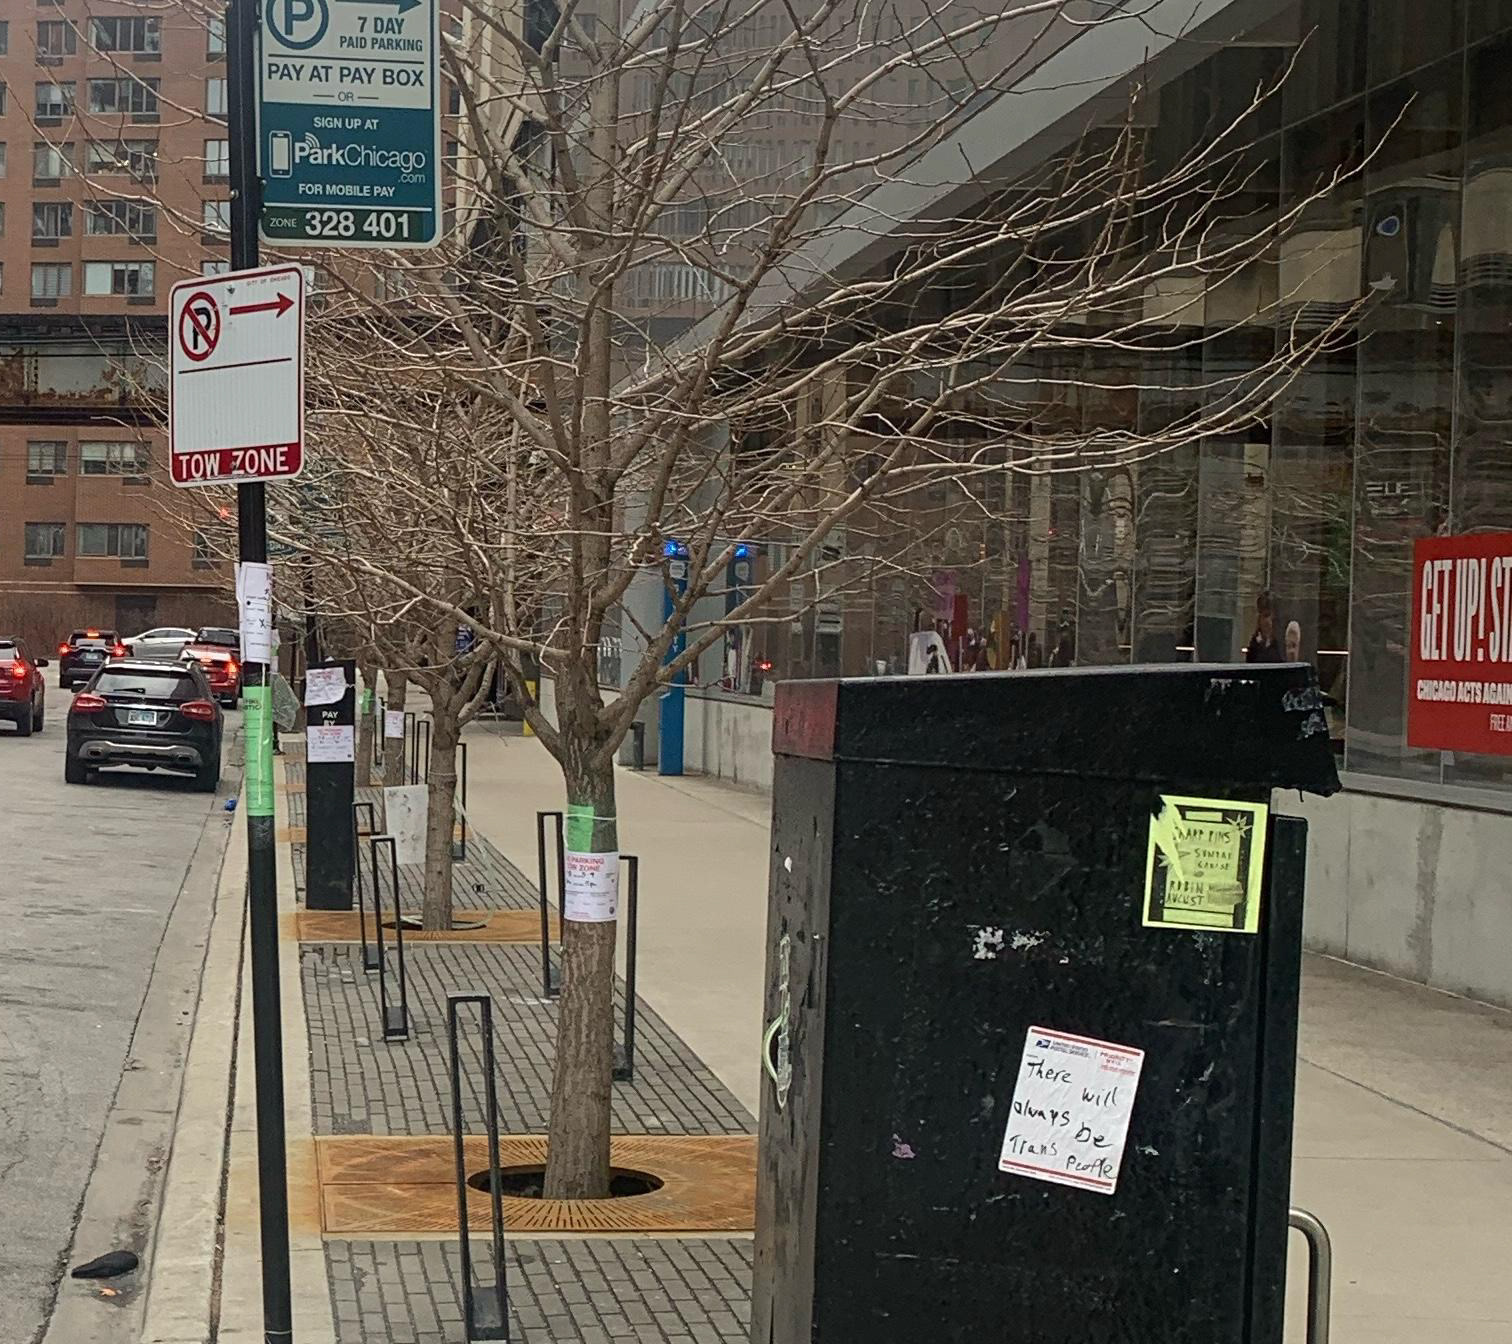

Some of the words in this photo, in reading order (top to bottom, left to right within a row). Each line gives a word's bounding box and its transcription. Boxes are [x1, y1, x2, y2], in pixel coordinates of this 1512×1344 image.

[357, 16, 368, 33] 7
[373, 17, 405, 34] DAY
[339, 36, 367, 49] PAID
[371, 38, 423, 52] PARKING
[267, 63, 305, 81] PAY
[308, 65, 333, 82] AT
[339, 67, 377, 85] PAY
[382, 69, 425, 87] BOX
[338, 91, 354, 102] OR
[313, 117, 342, 129] SIGN
[345, 118, 362, 129] UP
[364, 119, 379, 130] AT
[294, 141, 426, 173] ParkChicago
[398, 173, 426, 183] .com
[299, 184, 323, 195] FOR
[326, 185, 371, 196] MOBILE
[373, 186, 395, 197] PAY
[269, 217, 297, 228] ZONE
[305, 211, 356, 236] 328
[362, 212, 409, 238] 401
[179, 453, 220, 479] TOW
[231, 447, 289, 475] ZONE
[1420, 559, 1453, 661] GET
[1454, 557, 1487, 662] UP!
[1489, 556, 1512, 663] ST
[1416, 679, 1456, 702] CHICAGO
[1457, 681, 1483, 704] ACTS
[322, 711, 338, 719] PAY
[1165, 892, 1205, 906] AUGUST
[1027, 1059, 1072, 1083] There
[1081, 1087, 1118, 1106] will
[1013, 1100, 1070, 1127] always
[1009, 1134, 1058, 1157] Trans
[1075, 1122, 1113, 1148] be
